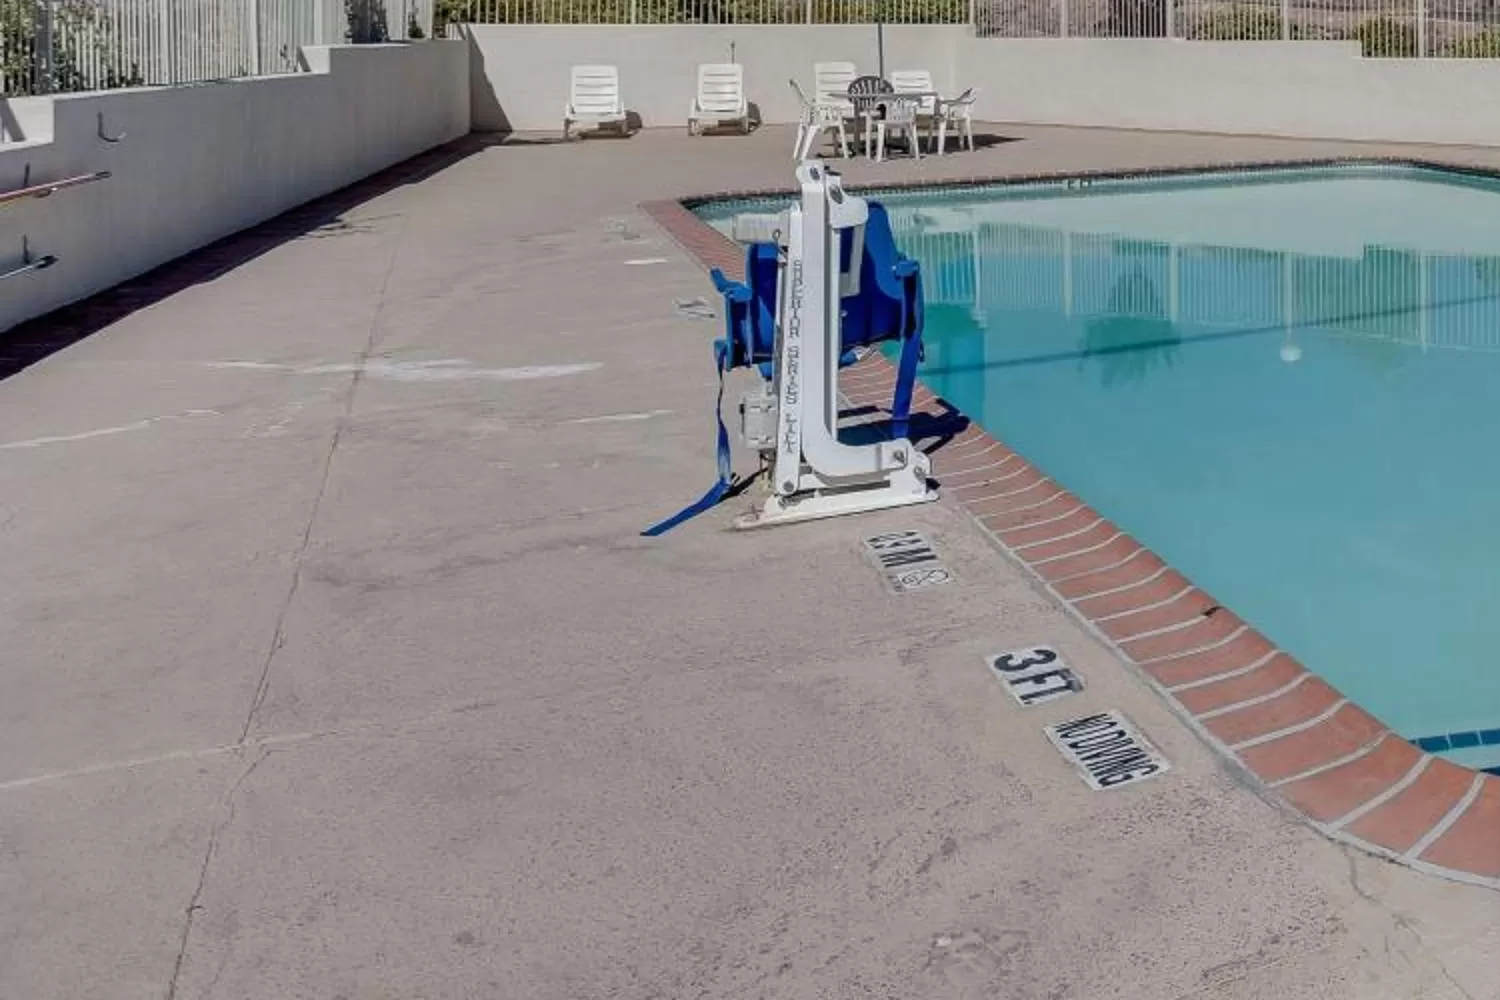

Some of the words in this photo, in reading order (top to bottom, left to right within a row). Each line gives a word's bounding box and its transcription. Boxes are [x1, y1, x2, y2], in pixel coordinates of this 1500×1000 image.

[994, 649, 1057, 673] 3
[1054, 712, 1118, 738] NO
[1067, 728, 1158, 787] DIVING
